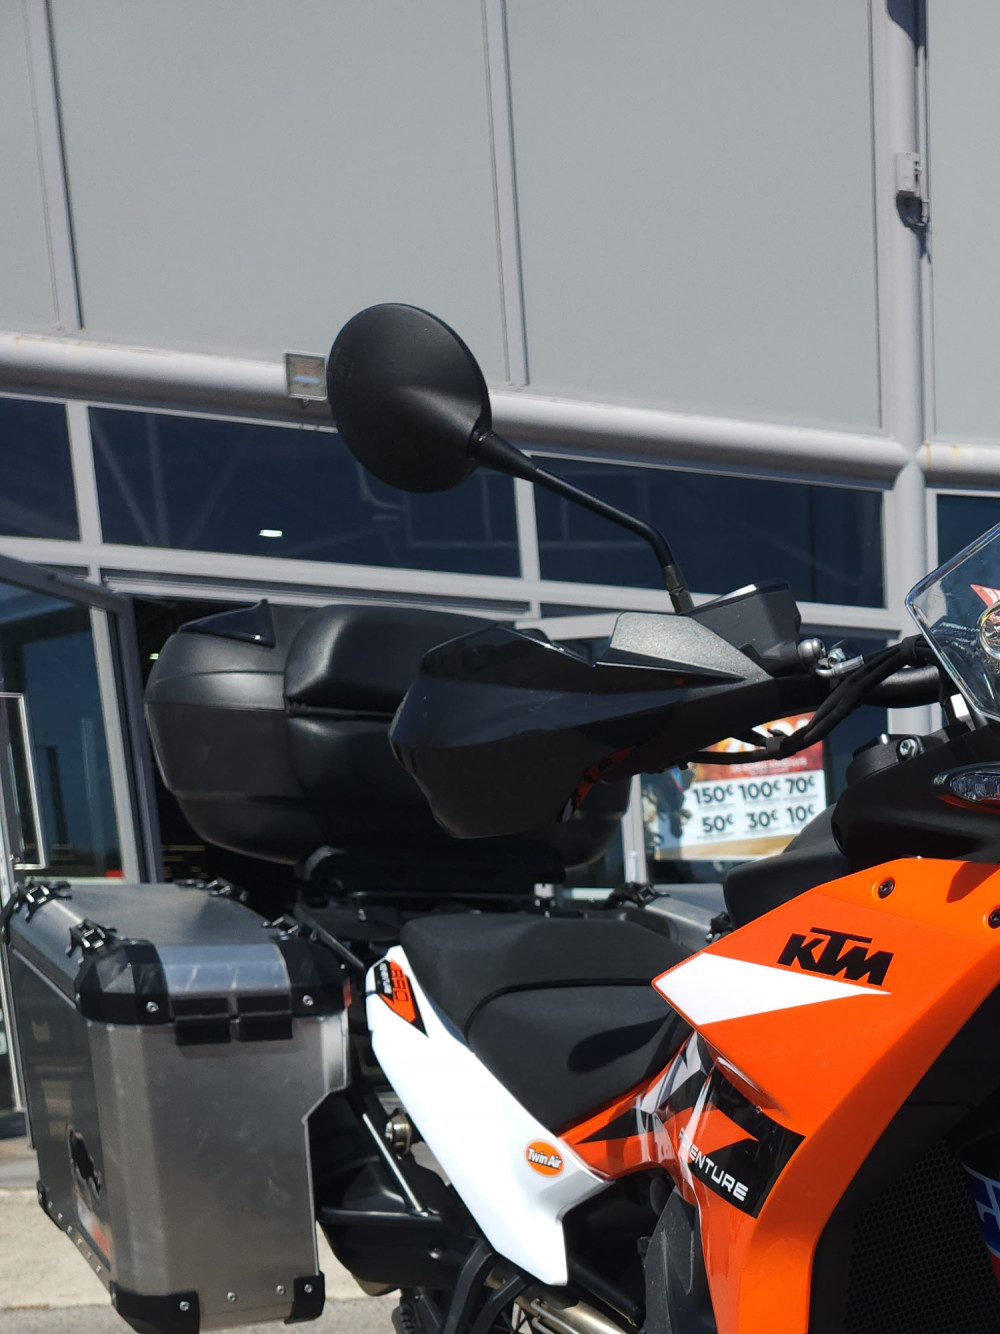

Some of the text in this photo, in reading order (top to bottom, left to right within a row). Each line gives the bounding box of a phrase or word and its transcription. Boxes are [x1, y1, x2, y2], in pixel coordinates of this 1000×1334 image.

[694, 775, 815, 804] 150€ 100€ 70€
[702, 813, 734, 833] 50€
[746, 809, 779, 829] 30€
[786, 804, 815, 823] 10€
[776, 926, 894, 986] KTM
[528, 1147, 563, 1170] Twin Air
